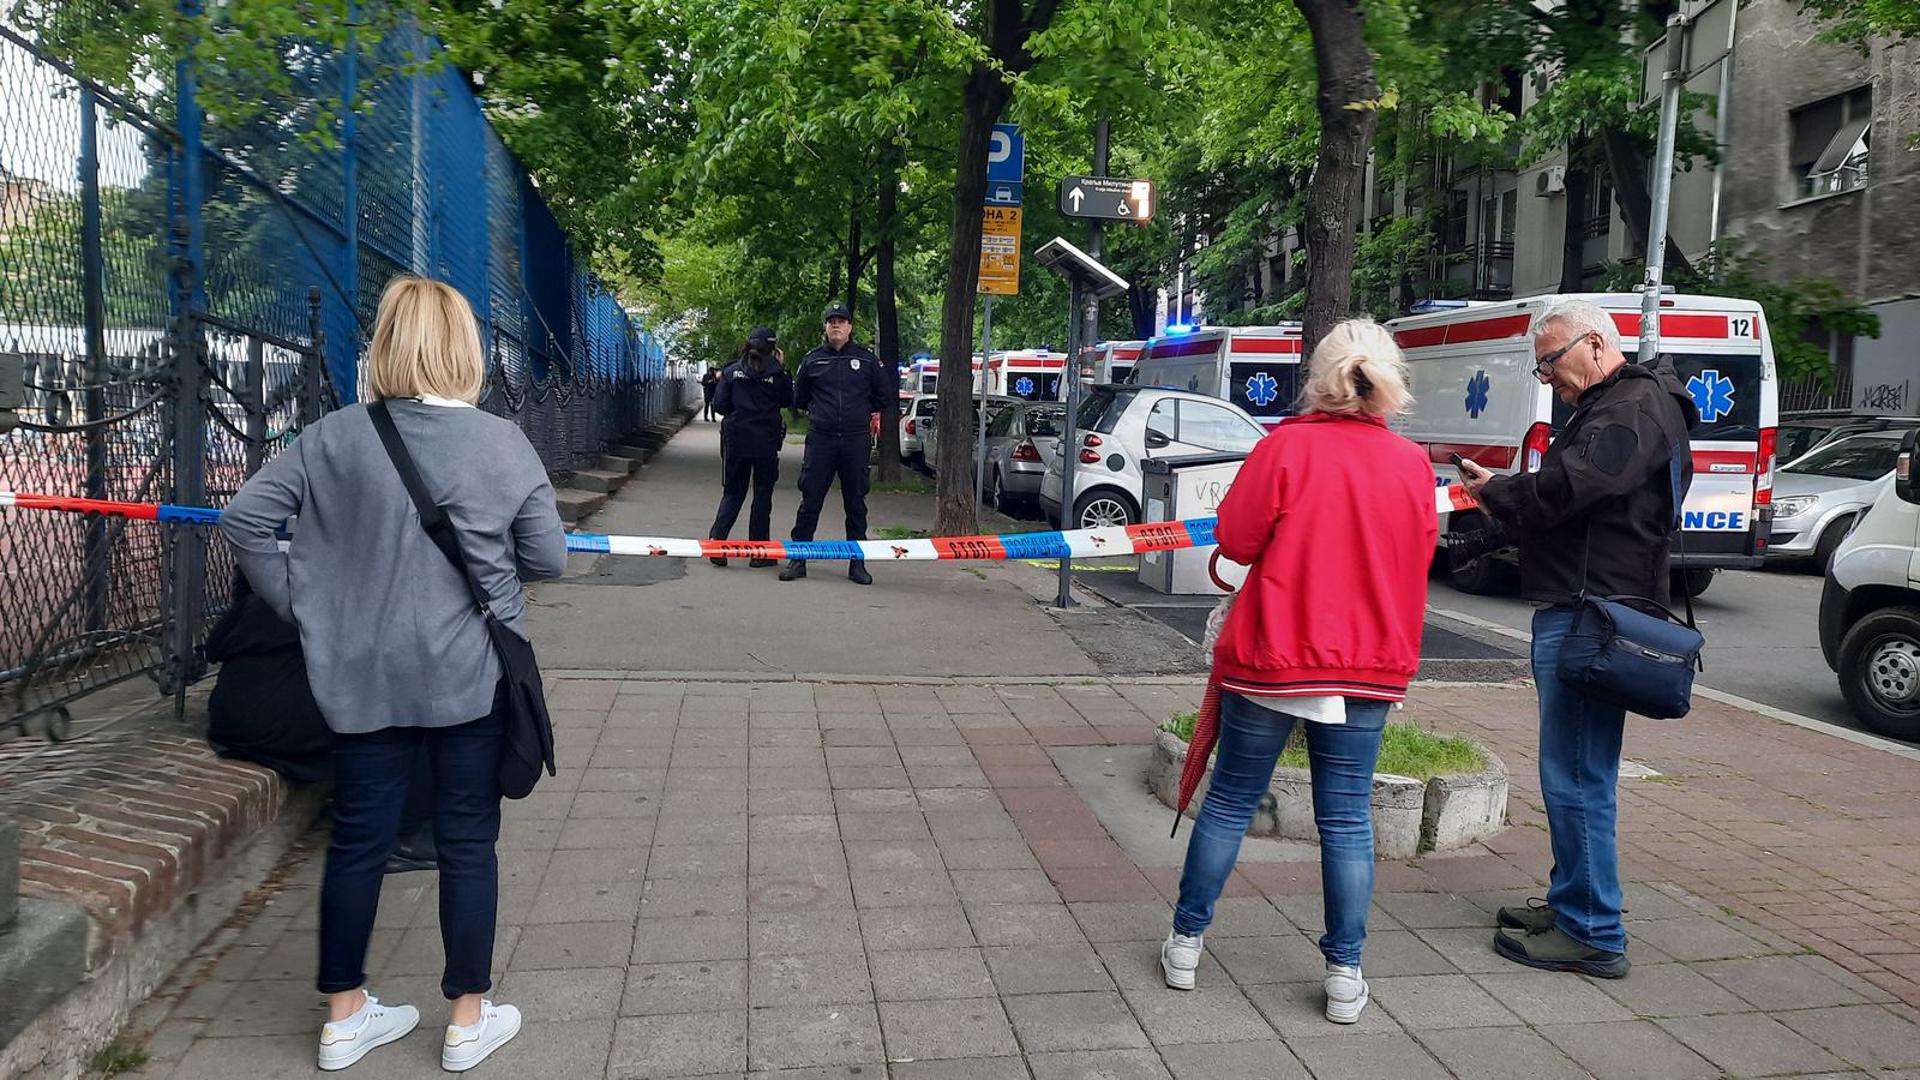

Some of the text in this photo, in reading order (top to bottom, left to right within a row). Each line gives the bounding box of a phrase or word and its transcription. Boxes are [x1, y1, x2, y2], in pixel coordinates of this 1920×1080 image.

[1009, 210, 1017, 221] 2
[1731, 318, 1749, 337] 12
[1684, 511, 1744, 529] NCE
[1140, 526, 1179, 547] СТОП
[949, 540, 991, 559] СТОП
